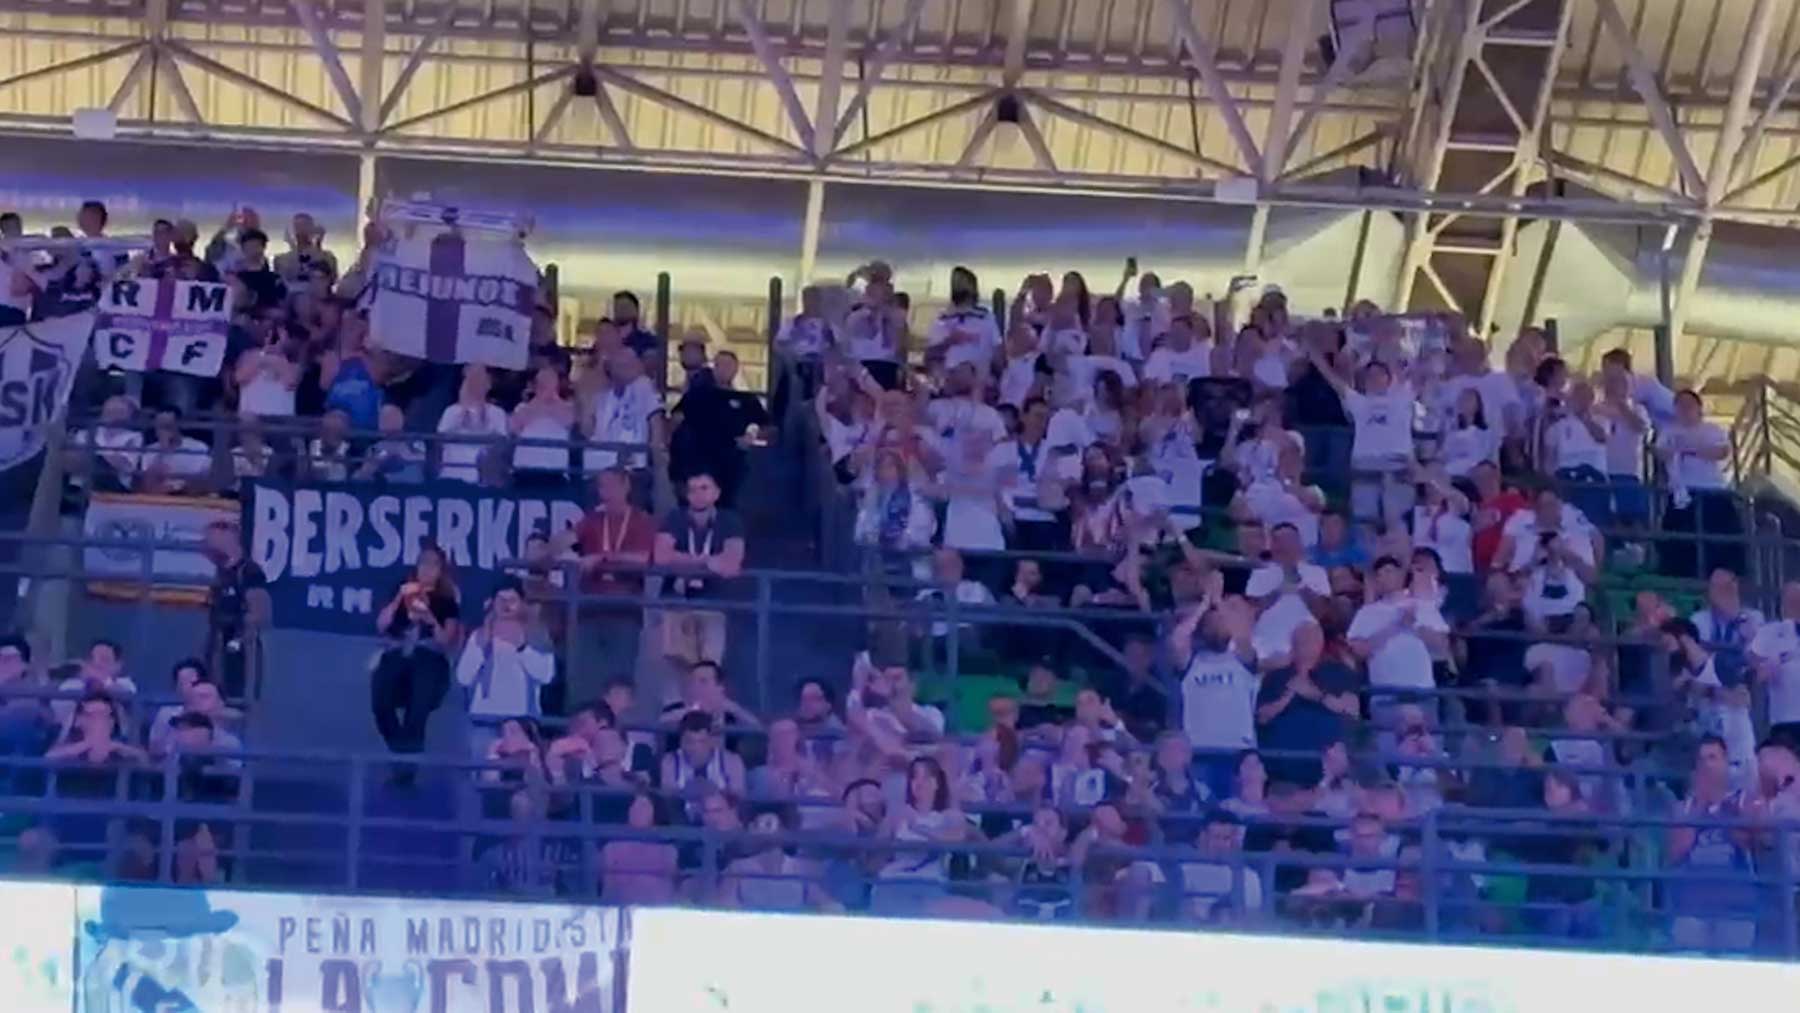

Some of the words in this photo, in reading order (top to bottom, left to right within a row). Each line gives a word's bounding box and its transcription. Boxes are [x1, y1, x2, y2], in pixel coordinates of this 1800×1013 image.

[111, 280, 140, 307] R
[187, 284, 227, 312] M
[110, 332, 135, 359] C
[181, 341, 208, 366] F
[279, 911, 377, 955] PEÑA
